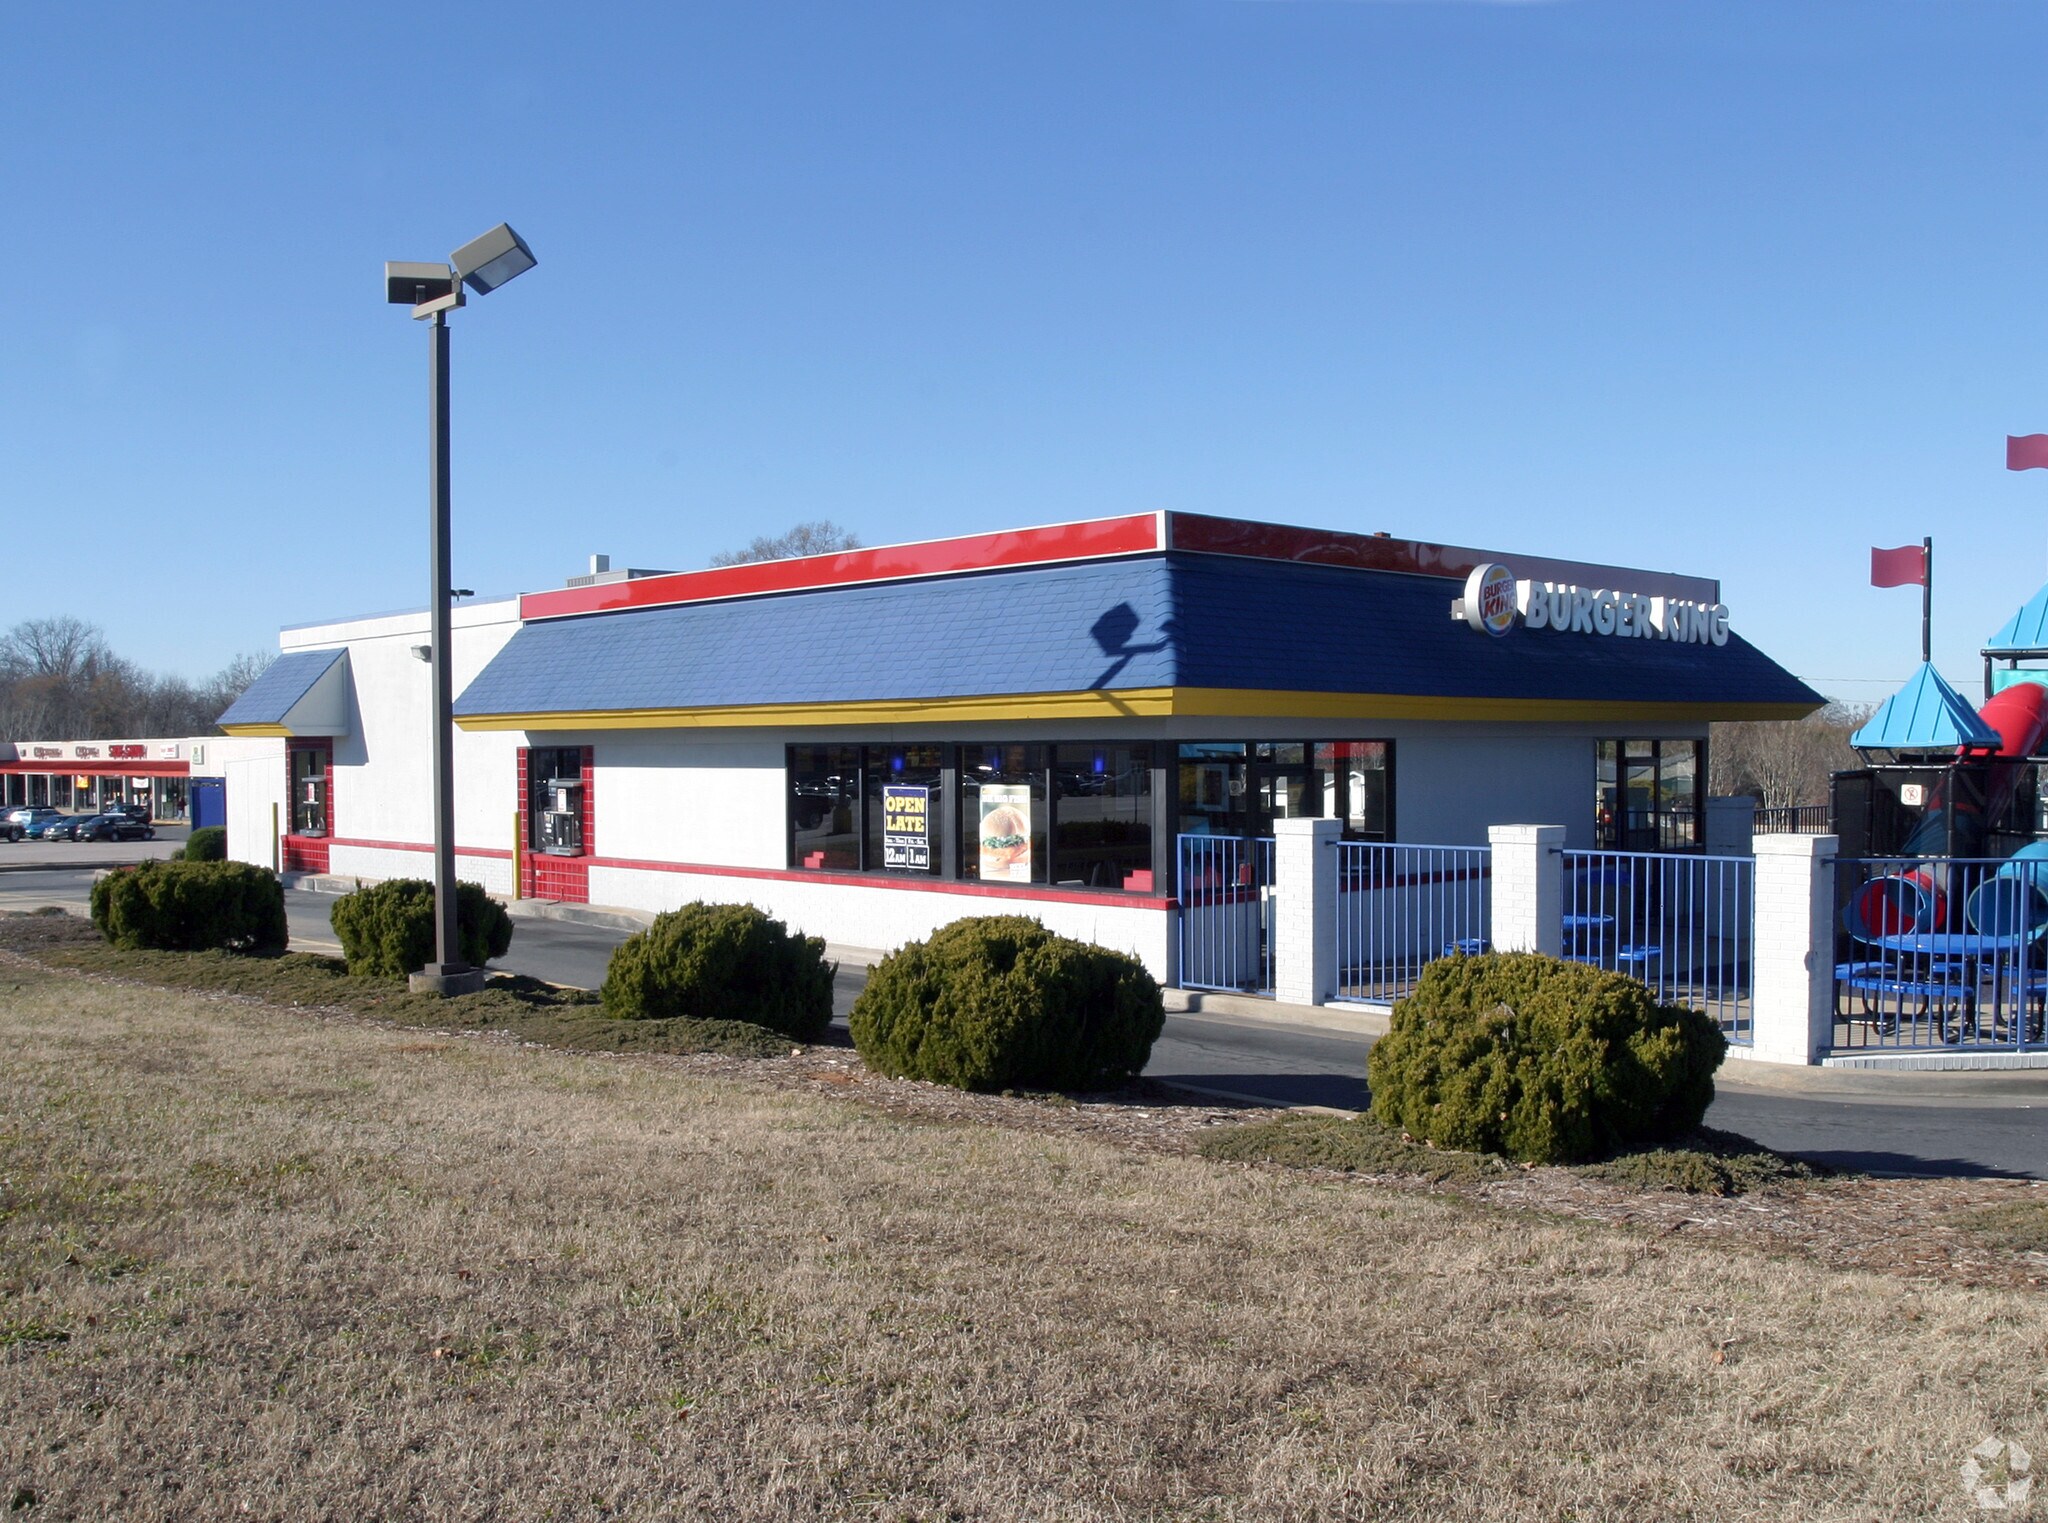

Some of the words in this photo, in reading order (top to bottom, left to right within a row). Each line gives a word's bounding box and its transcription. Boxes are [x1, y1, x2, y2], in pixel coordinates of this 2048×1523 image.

[1484, 579, 1514, 600] BURGER
[1483, 592, 1515, 619] KING
[1525, 580, 1653, 640] BURGER
[1659, 597, 1730, 646] KING
[885, 796, 926, 813] OPEN
[886, 815, 925, 832] LATE
